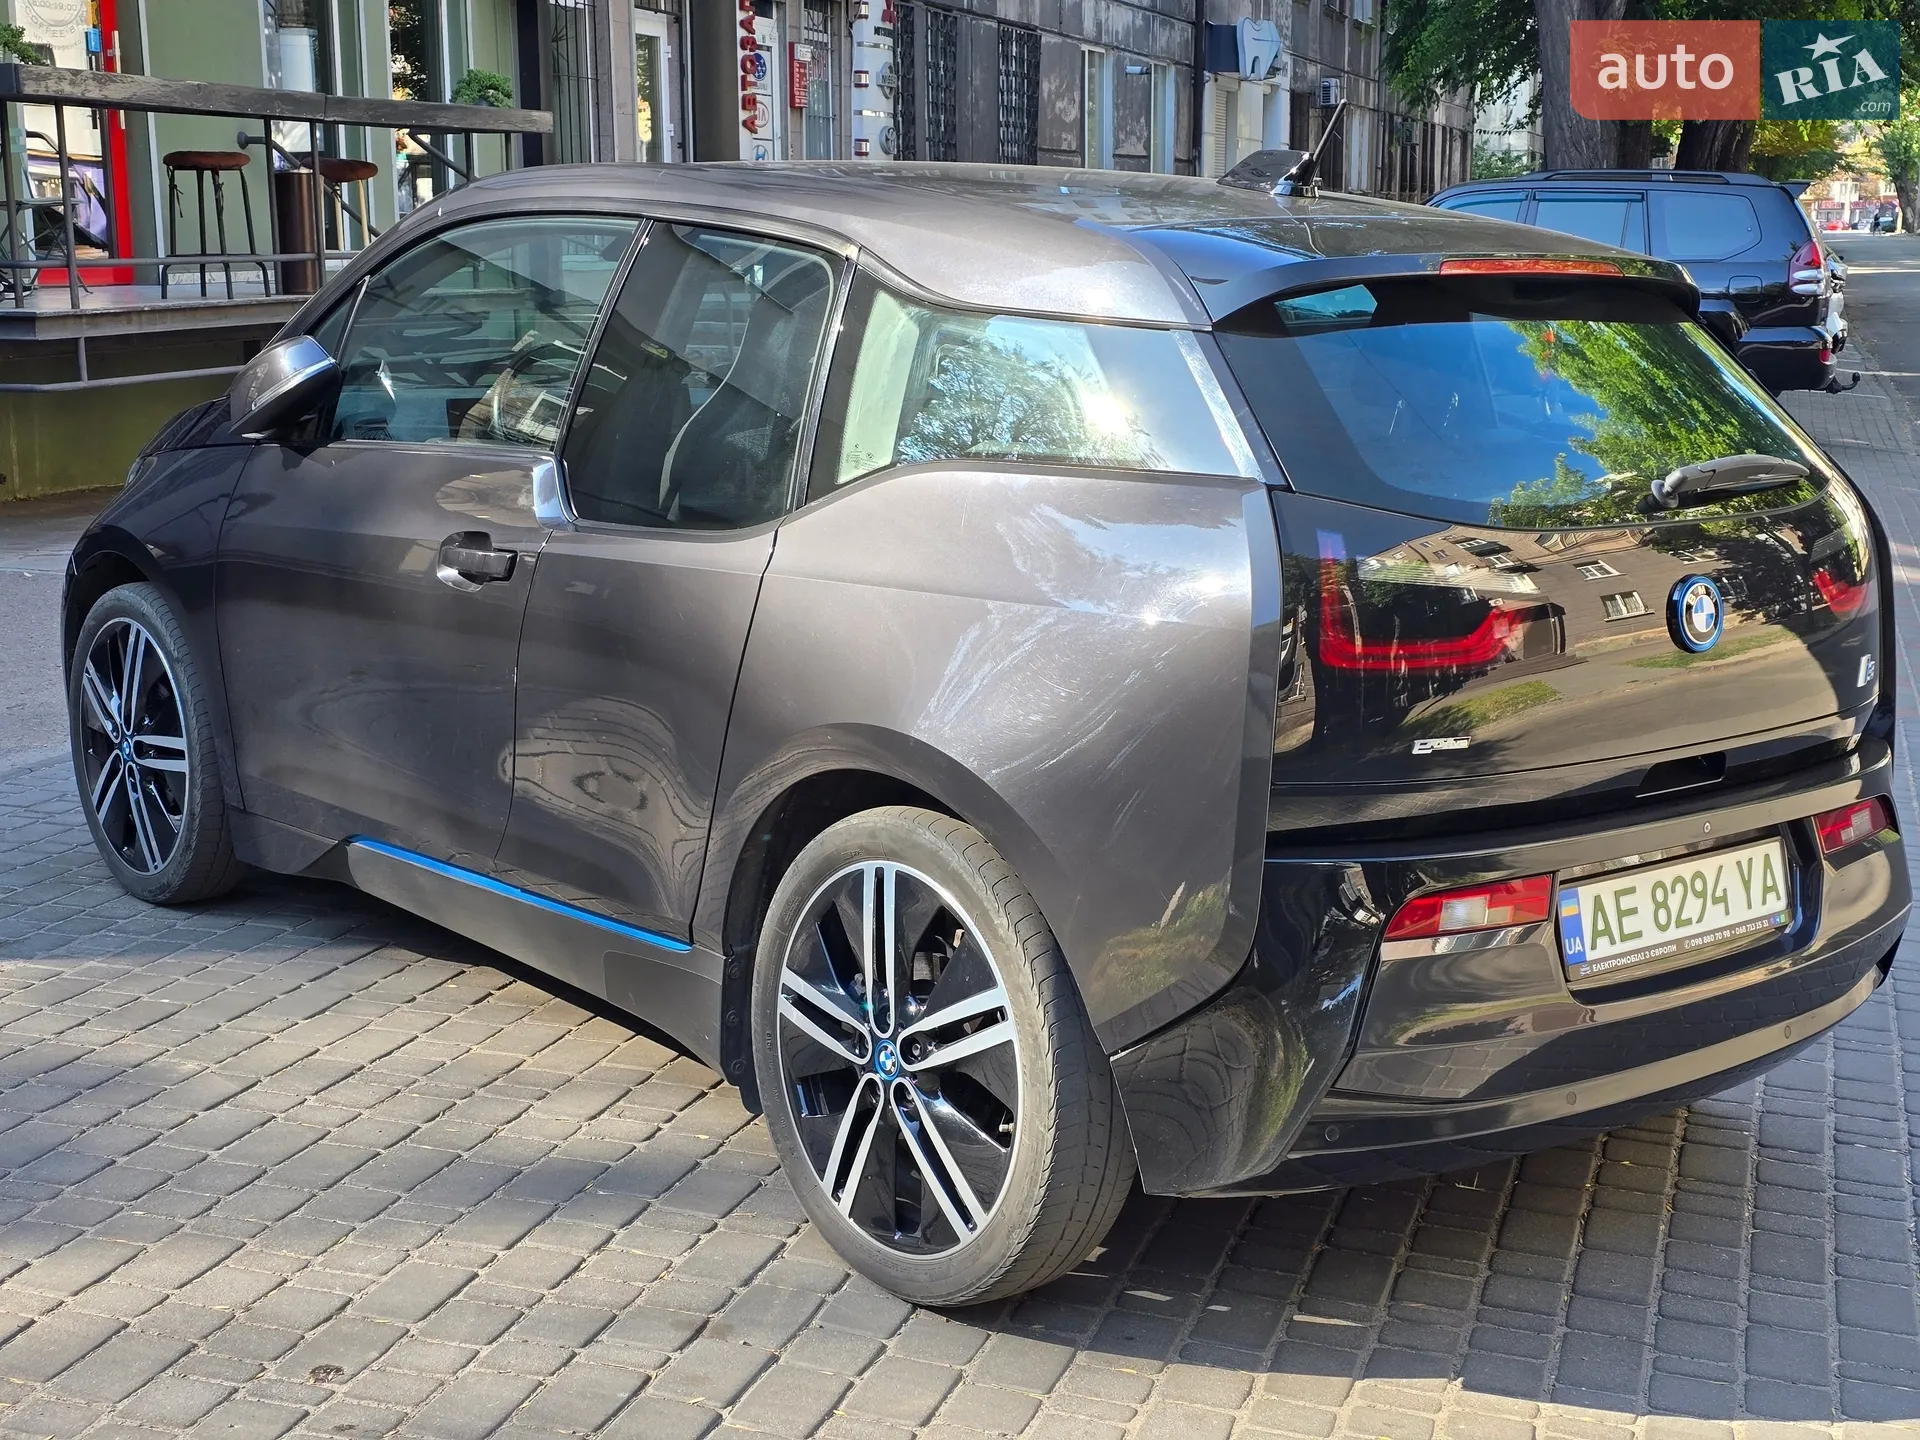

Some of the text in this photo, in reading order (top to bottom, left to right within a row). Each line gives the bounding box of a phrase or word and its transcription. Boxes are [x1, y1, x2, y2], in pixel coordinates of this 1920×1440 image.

[1591, 853, 1782, 950] AE 8294 YA
[1566, 936, 1584, 955] UA
[1592, 953, 1645, 972] ЕЛЕКТРОМОБІЛІ
[1650, 944, 1677, 957] ЄВРОПИ
[1690, 937, 1703, 947] 098
[1715, 930, 1723, 940] 70
[1723, 928, 1731, 938] 98
[1735, 924, 1747, 935] 068
